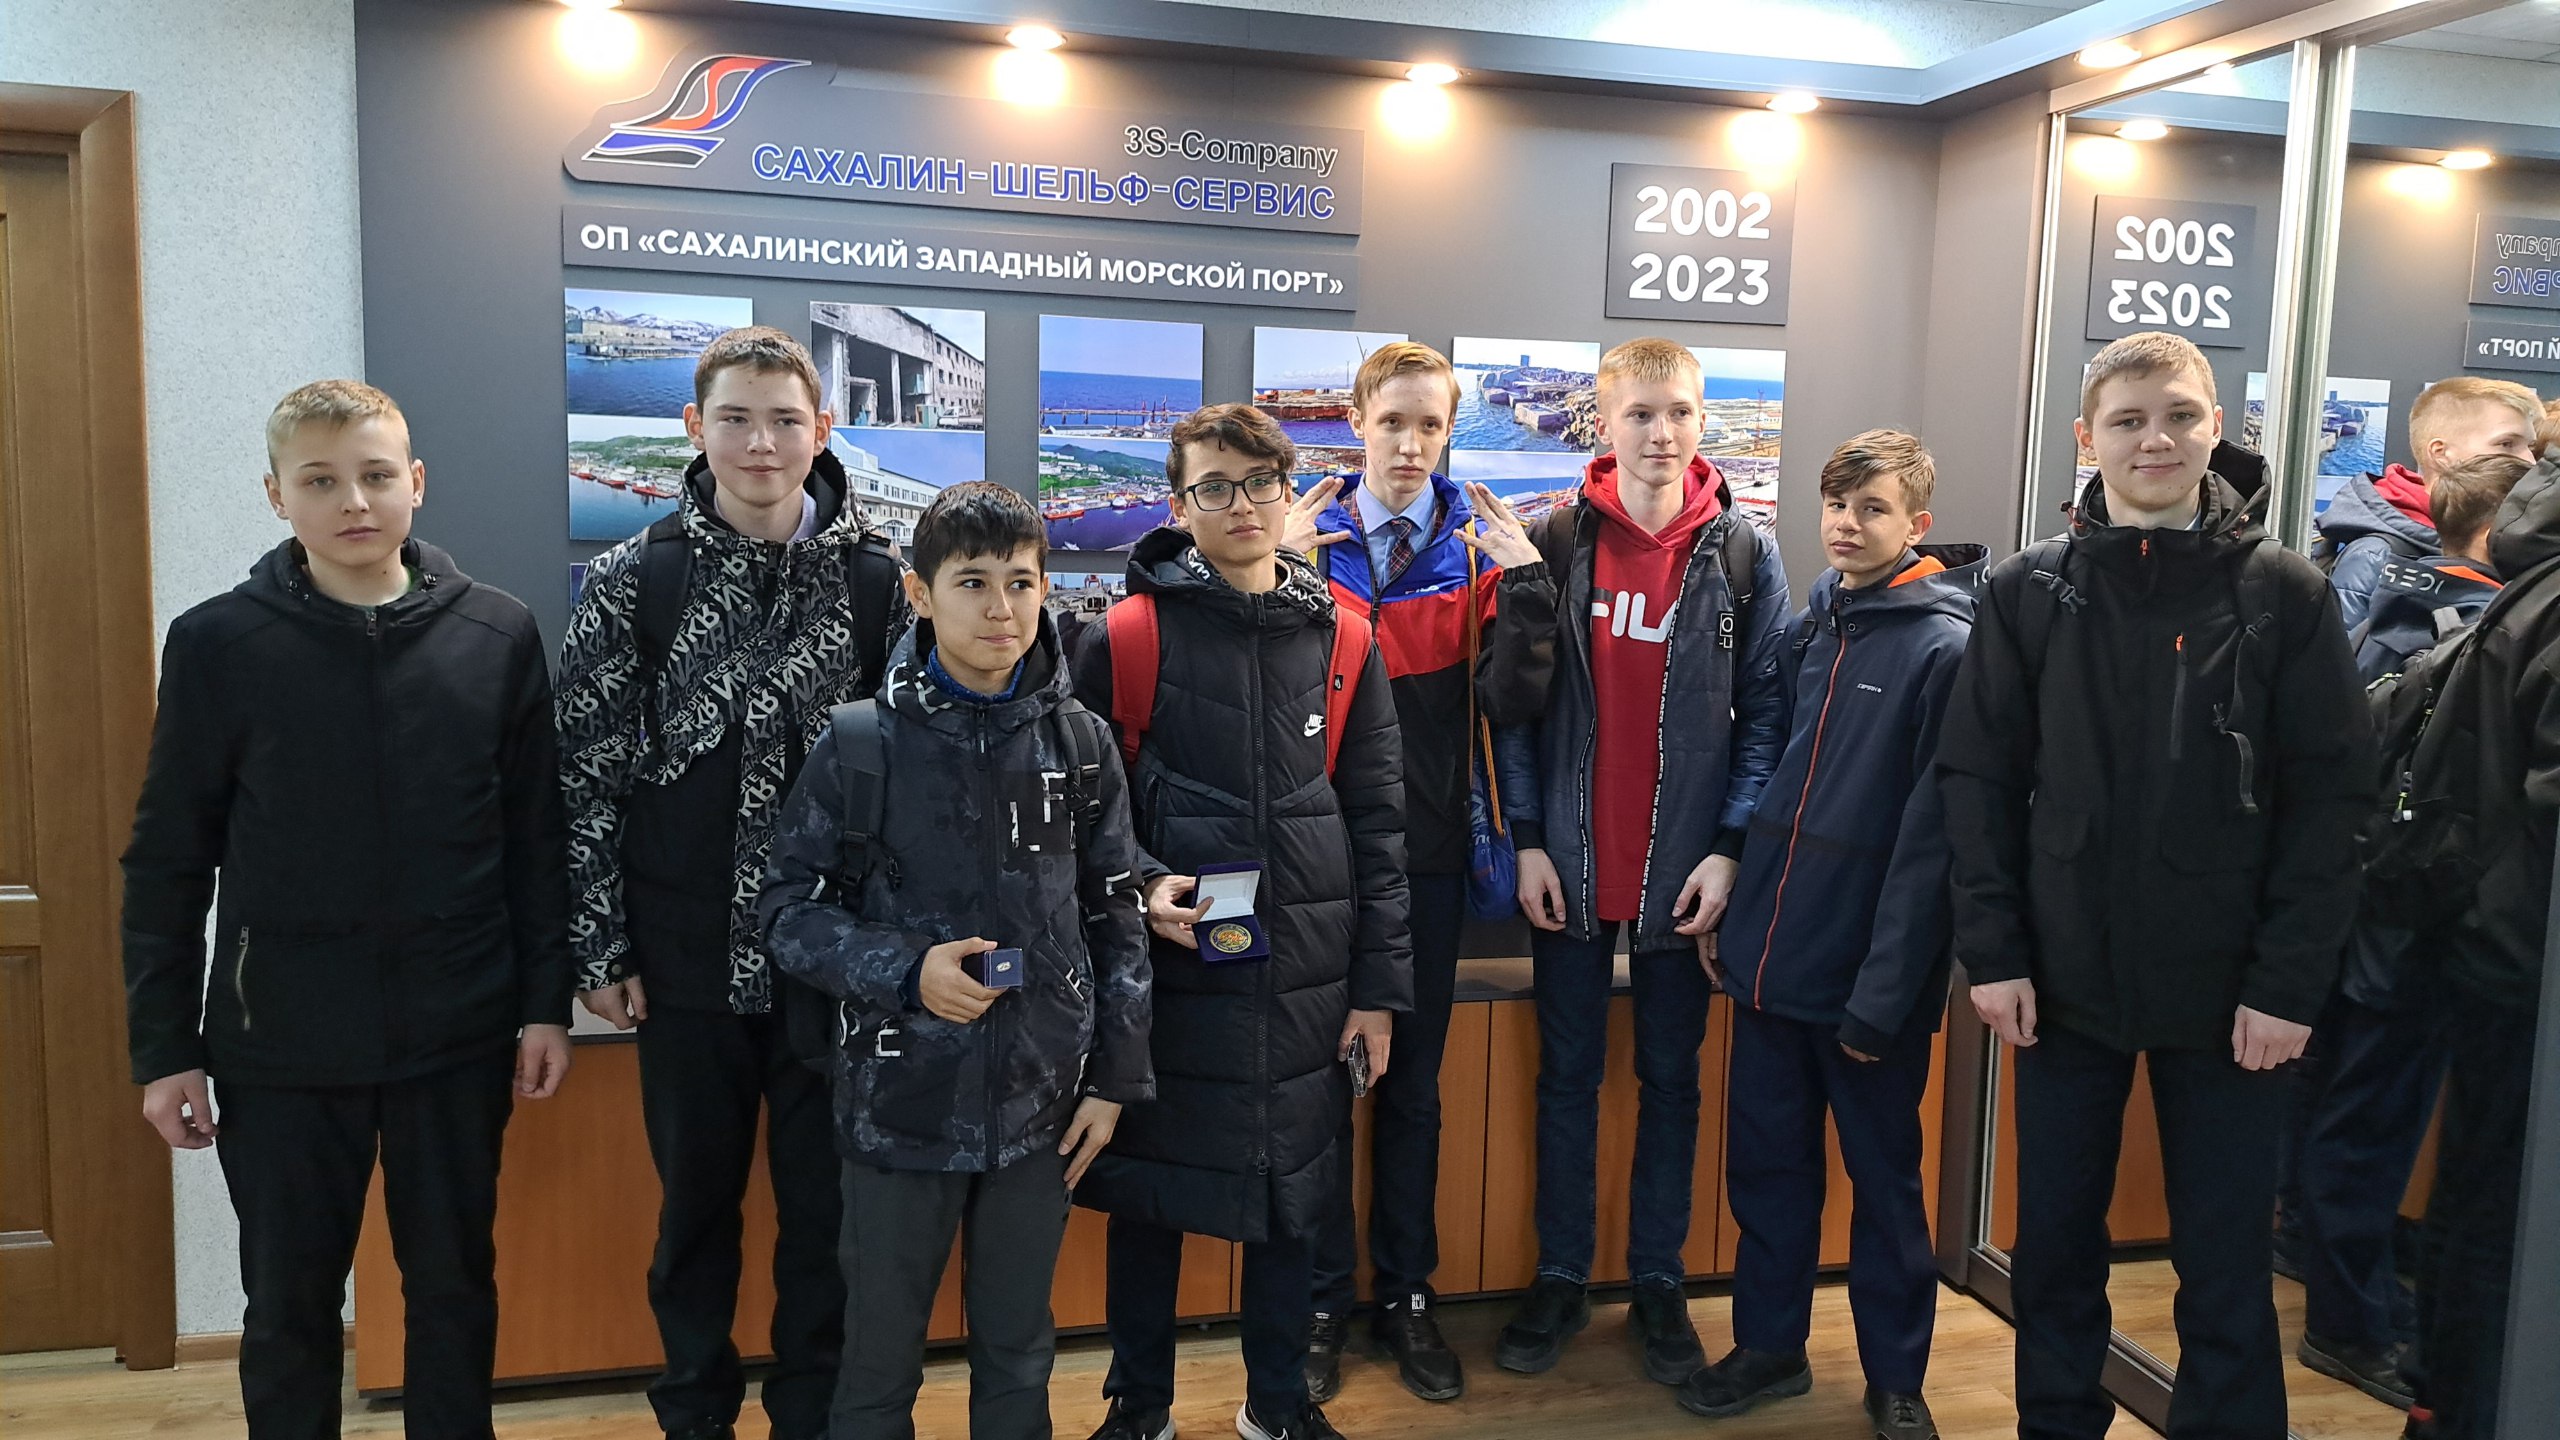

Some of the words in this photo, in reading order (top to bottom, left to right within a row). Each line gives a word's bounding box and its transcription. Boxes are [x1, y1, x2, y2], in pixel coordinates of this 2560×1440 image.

[1124, 125, 1338, 178] 3S-Company
[752, 143, 1335, 219] САХАЛИН-ШЕЛЬФ-СЕРВИС
[1634, 185, 1772, 240] 2002
[580, 224, 629, 251] ОП
[637, 229, 908, 269] «САХАЛИНСКИЙ
[916, 249, 1092, 280] ЗАПАДНЫЙ
[1100, 258, 1245, 290] МОРСКОЙ
[1253, 268, 1344, 295] ПОРТ»
[1628, 252, 1770, 306] 2023
